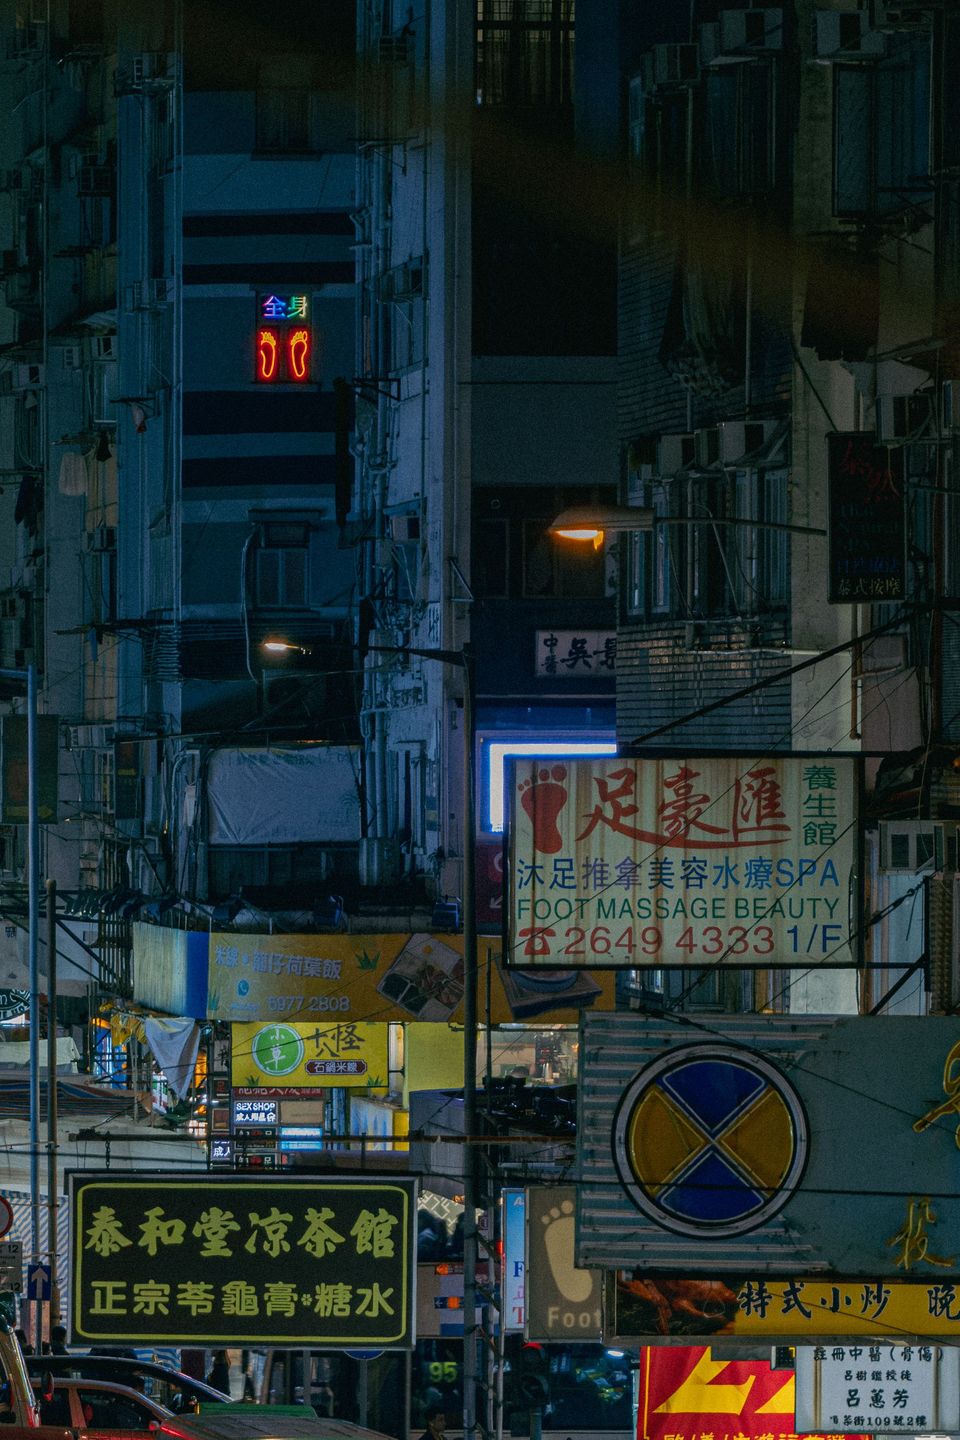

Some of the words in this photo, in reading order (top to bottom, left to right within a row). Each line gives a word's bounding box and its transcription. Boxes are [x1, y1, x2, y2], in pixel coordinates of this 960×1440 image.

[261, 295, 307, 318] 全身
[575, 765, 792, 849] 足豪匯
[803, 764, 838, 847] 養生館
[518, 897, 587, 921] FOOT
[597, 897, 726, 921] MASSAGE
[734, 897, 841, 921] BEAUTY
[565, 925, 662, 955] 2649
[675, 925, 775, 955] 4333
[786, 925, 842, 956] 1/F
[308, 996, 351, 1012] 2808
[236, 1102, 252, 1111] SEX
[253, 1102, 276, 1112] SHOP
[313, 1281, 396, 1319] 糖水
